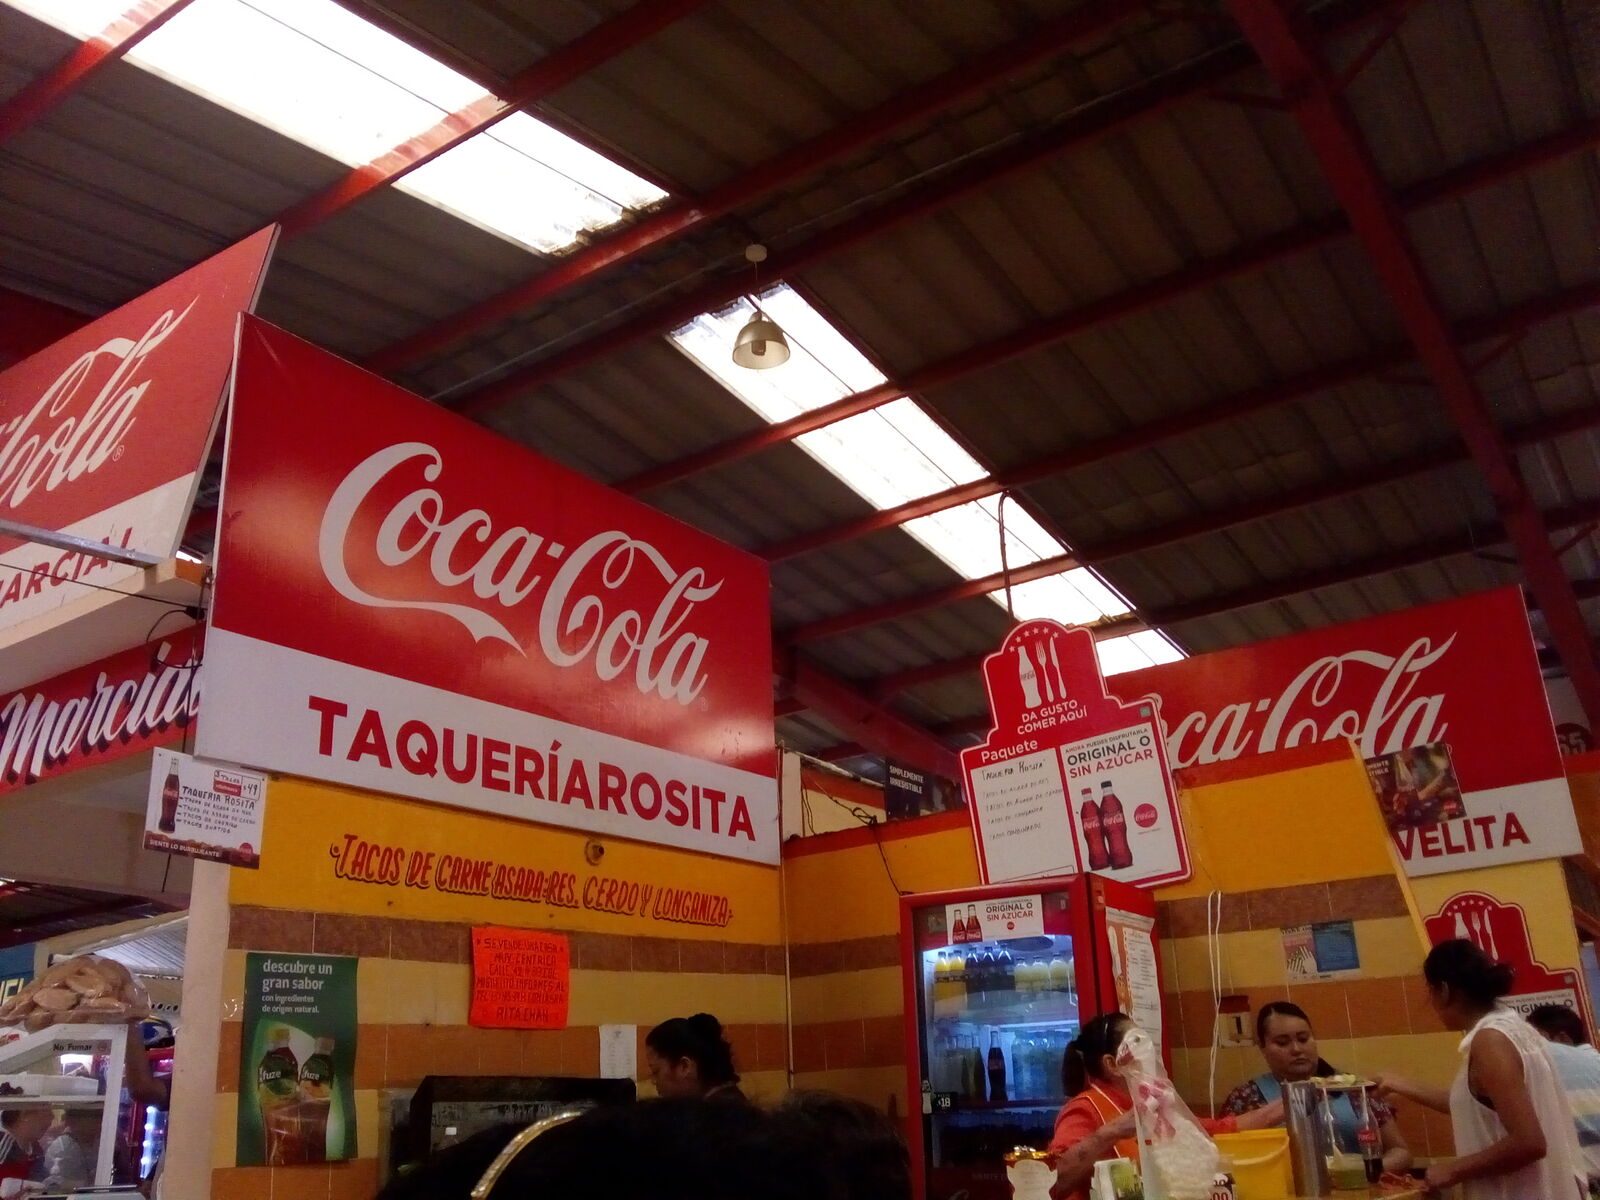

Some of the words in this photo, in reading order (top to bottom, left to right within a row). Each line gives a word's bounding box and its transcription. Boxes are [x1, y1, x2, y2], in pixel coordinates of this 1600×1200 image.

[319, 441, 724, 705] Coca-Cola
[1022, 711, 1038, 723] DA
[1040, 700, 1078, 717] GUSTO
[1017, 717, 1057, 735] COMER
[1060, 705, 1088, 724] AQUÍ
[981, 738, 1039, 763] Paquete
[1067, 740, 1136, 766] ORIGINAL
[1139, 735, 1151, 747] O
[1069, 764, 1092, 779] SIN
[182, 785, 220, 802] TAQUERIA
[224, 795, 255, 810] ROSITA
[339, 833, 406, 882] TACOS
[406, 850, 436, 887] DE
[437, 854, 494, 893] CARNE
[584, 876, 639, 912] CERDO
[985, 902, 1025, 913] ORIGINAL
[263, 959, 316, 975] descubre
[318, 964, 333, 975] un
[262, 978, 290, 993] gran
[292, 977, 325, 990] sabor
[262, 995, 274, 1003] con
[275, 994, 314, 1005] ingredientes
[262, 1005, 271, 1013] de
[272, 1004, 293, 1015] origen
[294, 1005, 320, 1014] natural.
[53, 1043, 65, 1051] No
[67, 1043, 92, 1051] Fumar
[262, 1070, 282, 1081] fuze
